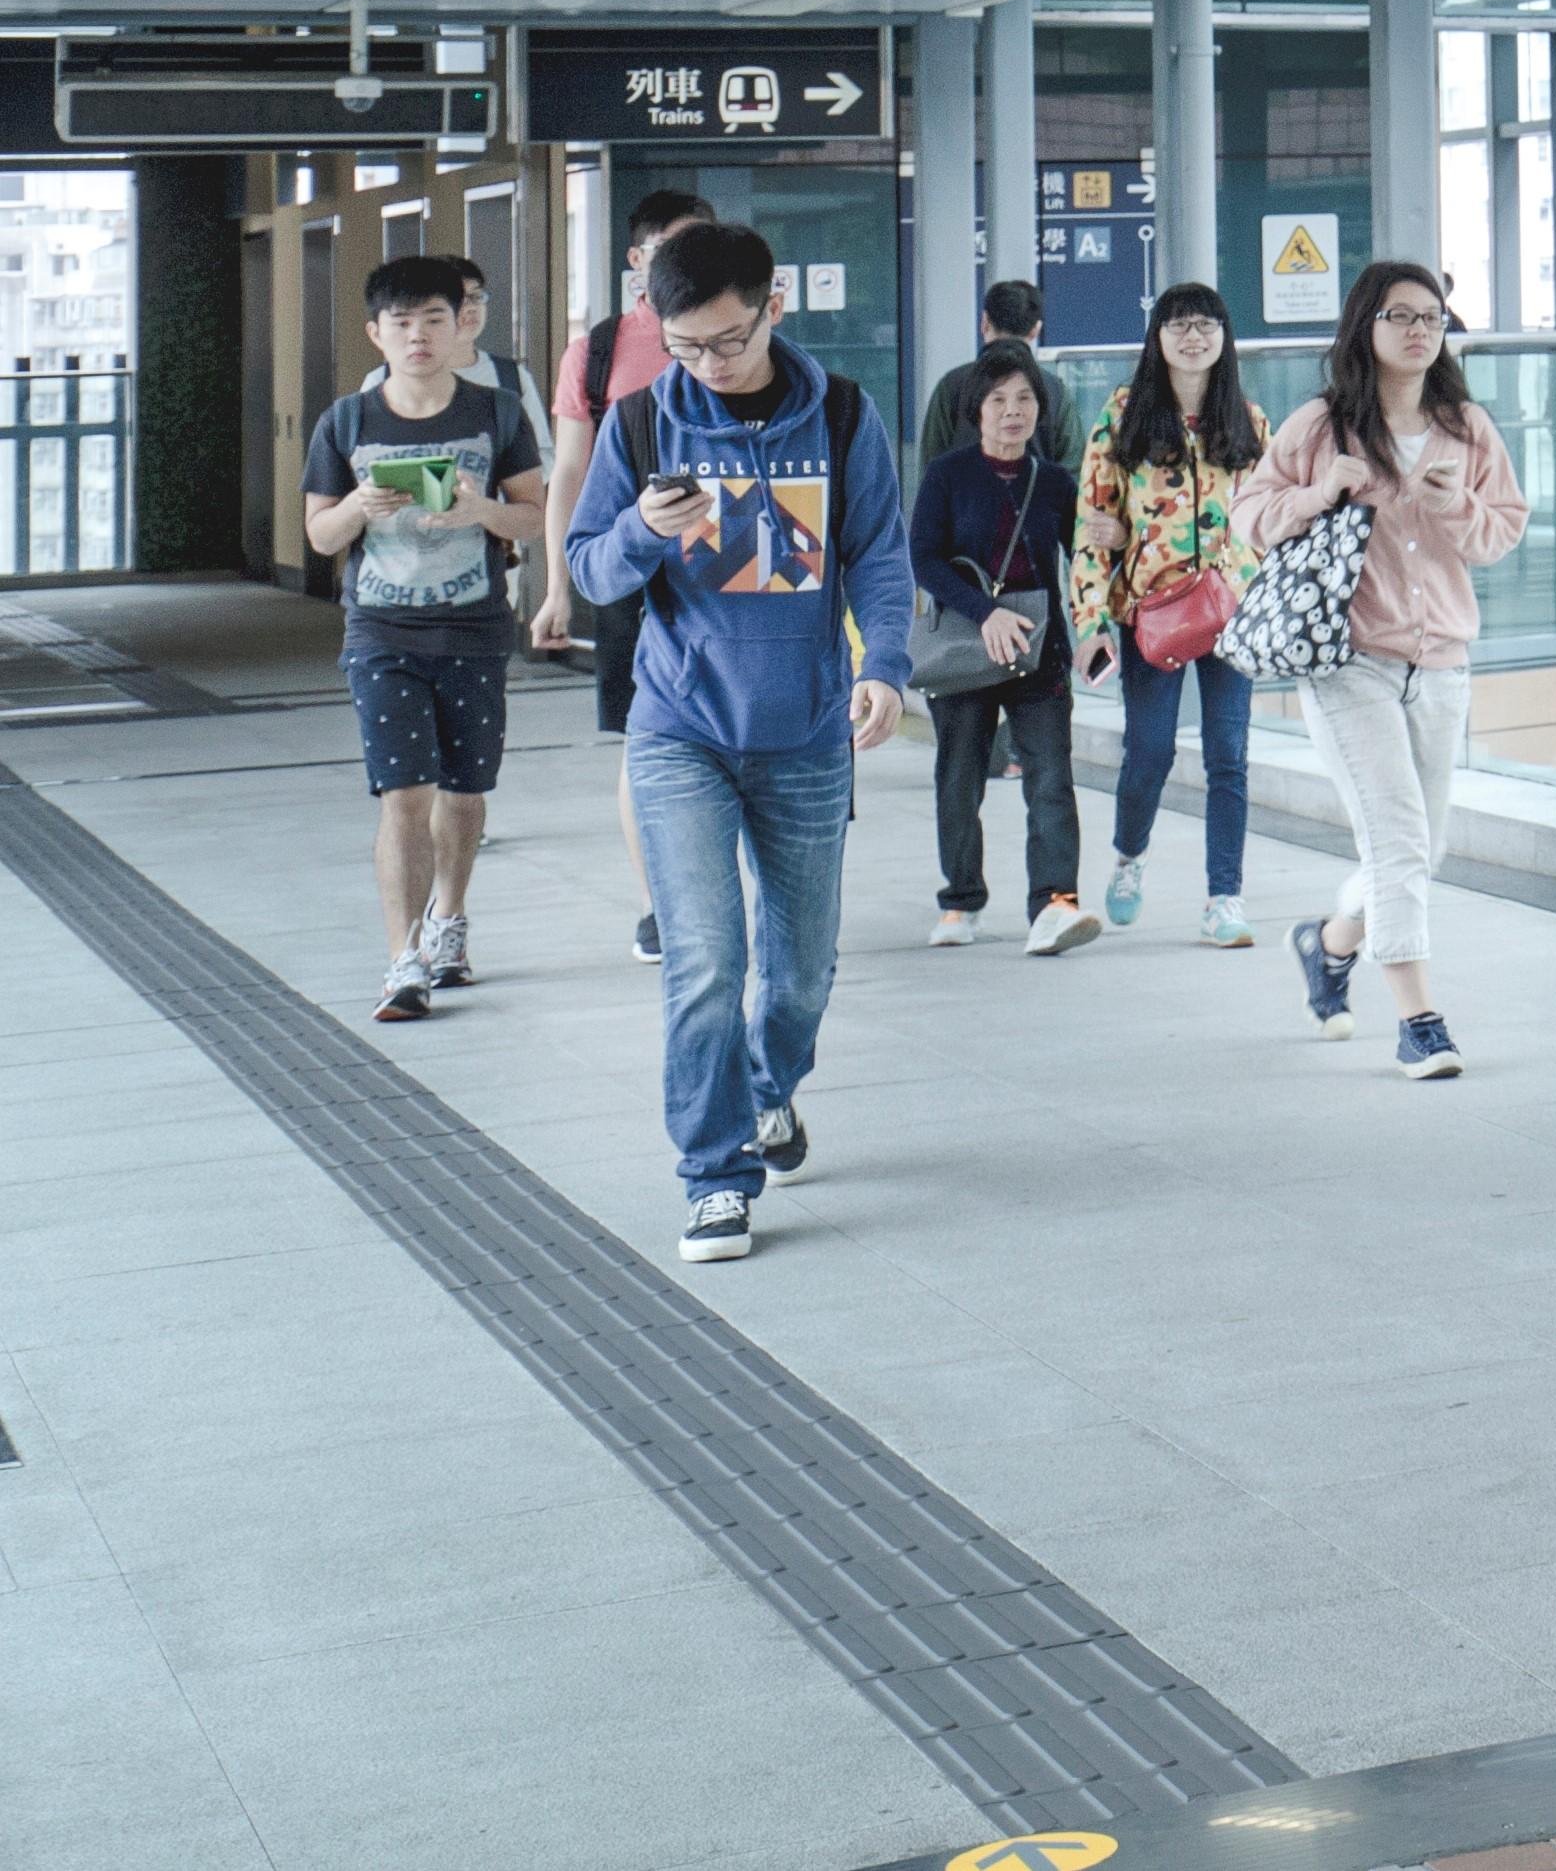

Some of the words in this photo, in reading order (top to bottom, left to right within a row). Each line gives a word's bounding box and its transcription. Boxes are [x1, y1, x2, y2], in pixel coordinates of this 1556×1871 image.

[626, 66, 704, 105] 列車
[648, 106, 705, 126] Trains
[1034, 171, 1066, 195] 機
[679, 459, 828, 476] HOLLSTER
[359, 569, 415, 605] HIGH
[424, 586, 438, 603] &
[443, 561, 484, 600] DRY
